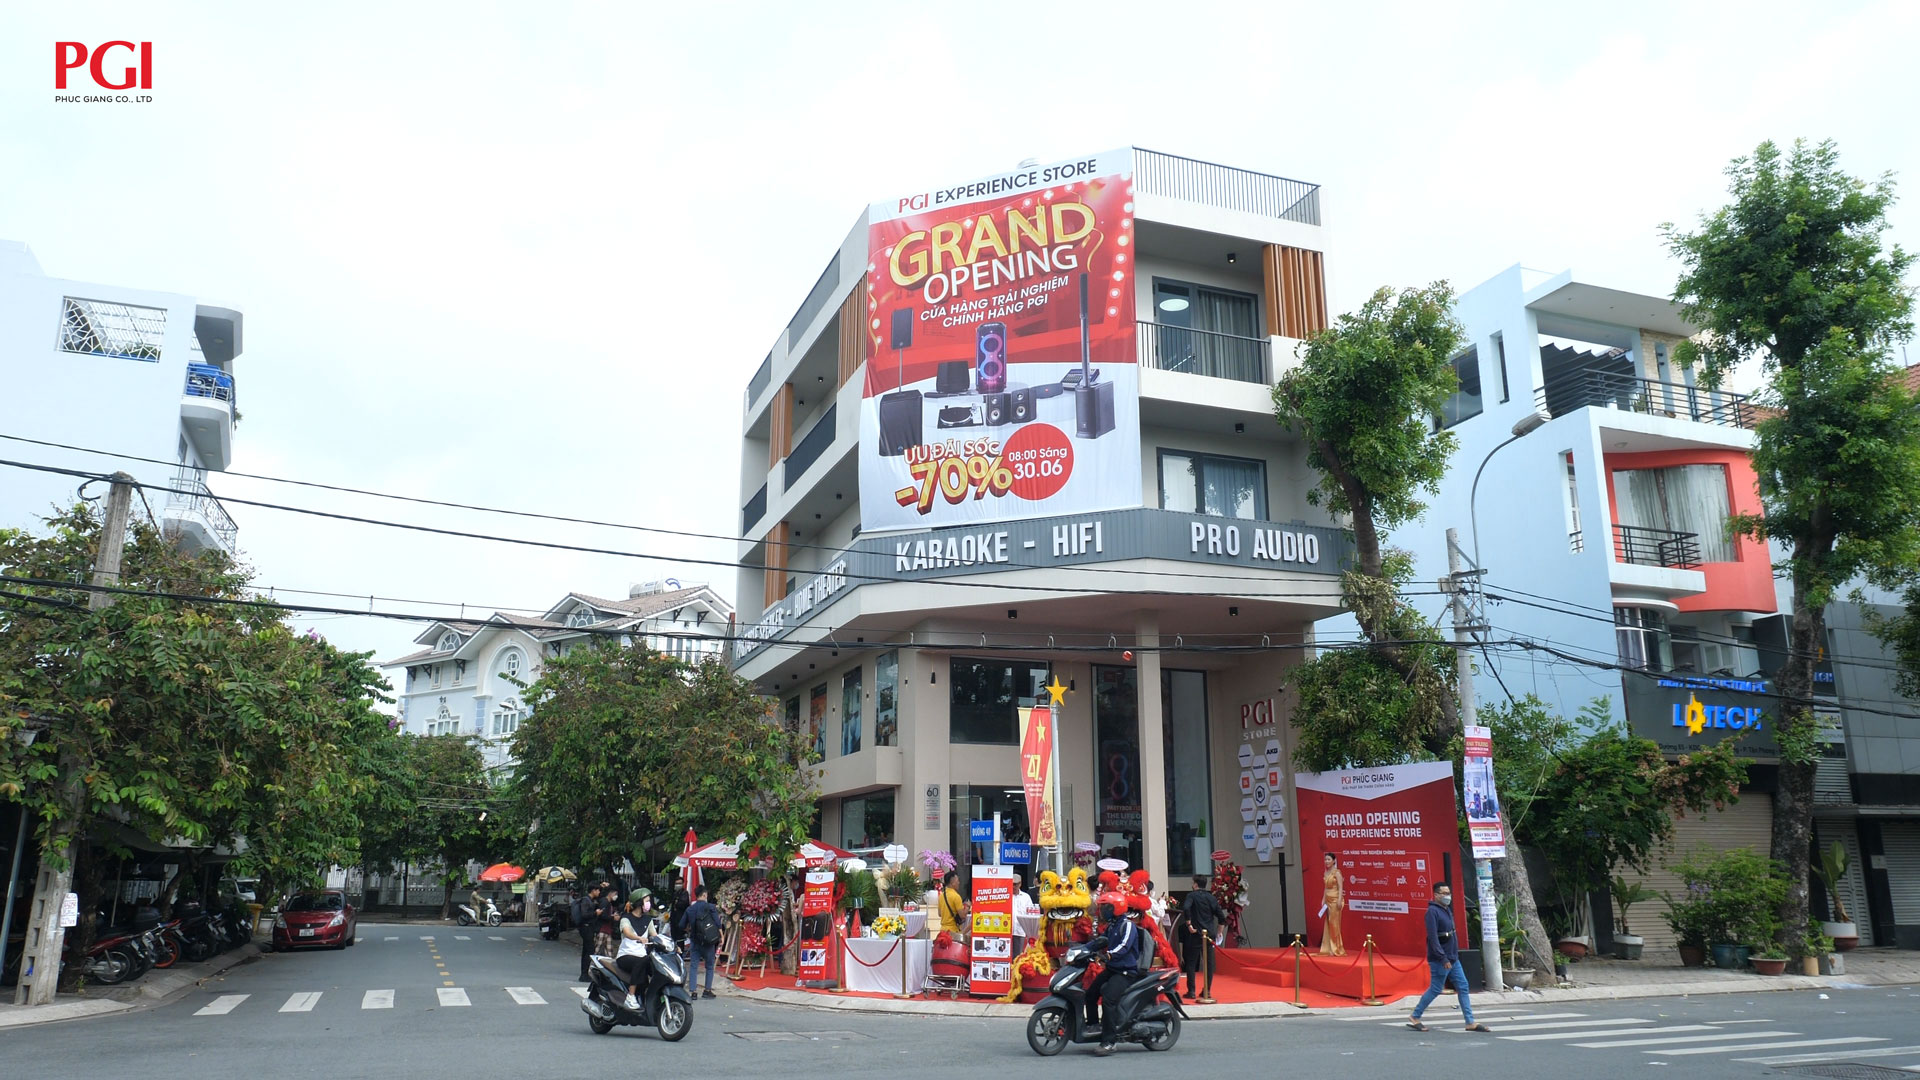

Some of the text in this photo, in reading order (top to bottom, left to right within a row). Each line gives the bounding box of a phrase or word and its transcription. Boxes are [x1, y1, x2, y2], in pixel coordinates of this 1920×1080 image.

[898, 158, 1097, 214] PGI EXPERIENCE STORE
[889, 202, 1096, 287] GRAND
[923, 244, 1078, 304] OPENING
[1020, 275, 1069, 299] NGHIỆM
[943, 311, 984, 327] CHÍNH
[1027, 294, 1048, 309] PGI
[1008, 446, 1068, 463] 08:00 Sáng
[1014, 458, 1064, 480] 30.06
[896, 456, 1013, 513] -70%
[895, 531, 1009, 573] KARAOKE
[1053, 521, 1104, 558] HIFI
[1191, 521, 1320, 565] PRO AUDIO
[814, 561, 847, 605] THEATER
[1241, 699, 1276, 729] PGI
[1243, 727, 1276, 741] STORE
[1353, 773, 1370, 784] PHÚC
[1371, 772, 1395, 783] GIANG
[926, 787, 939, 797] 60
[1325, 811, 1420, 826] GRAND OPENING
[1325, 827, 1422, 839] PGI EXPERIENCE STORE
[987, 867, 999, 875] PGI
